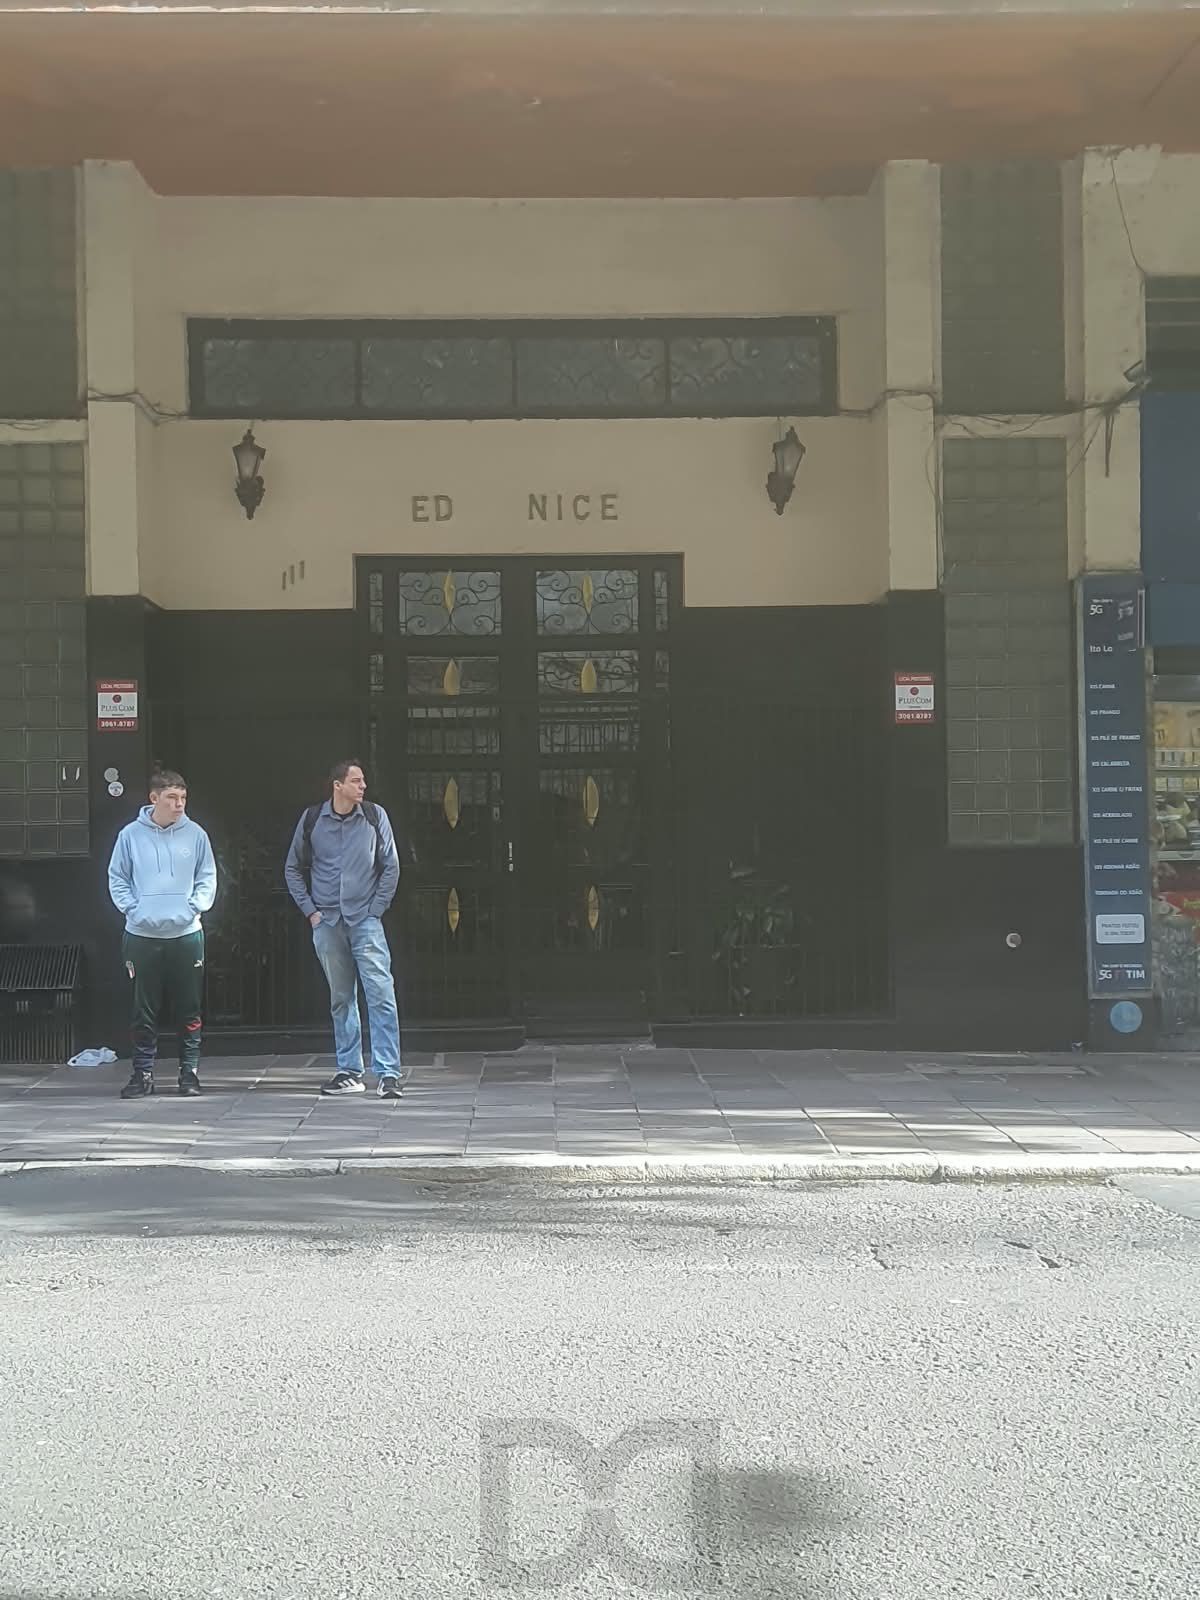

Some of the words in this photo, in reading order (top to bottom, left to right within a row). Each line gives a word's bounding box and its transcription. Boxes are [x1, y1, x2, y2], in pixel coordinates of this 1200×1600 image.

[411, 495, 453, 522] ED
[528, 493, 618, 520] NICE
[1089, 604, 1103, 616] 5G
[1098, 969, 1112, 981] 5G
[1126, 969, 1145, 980] TIM
